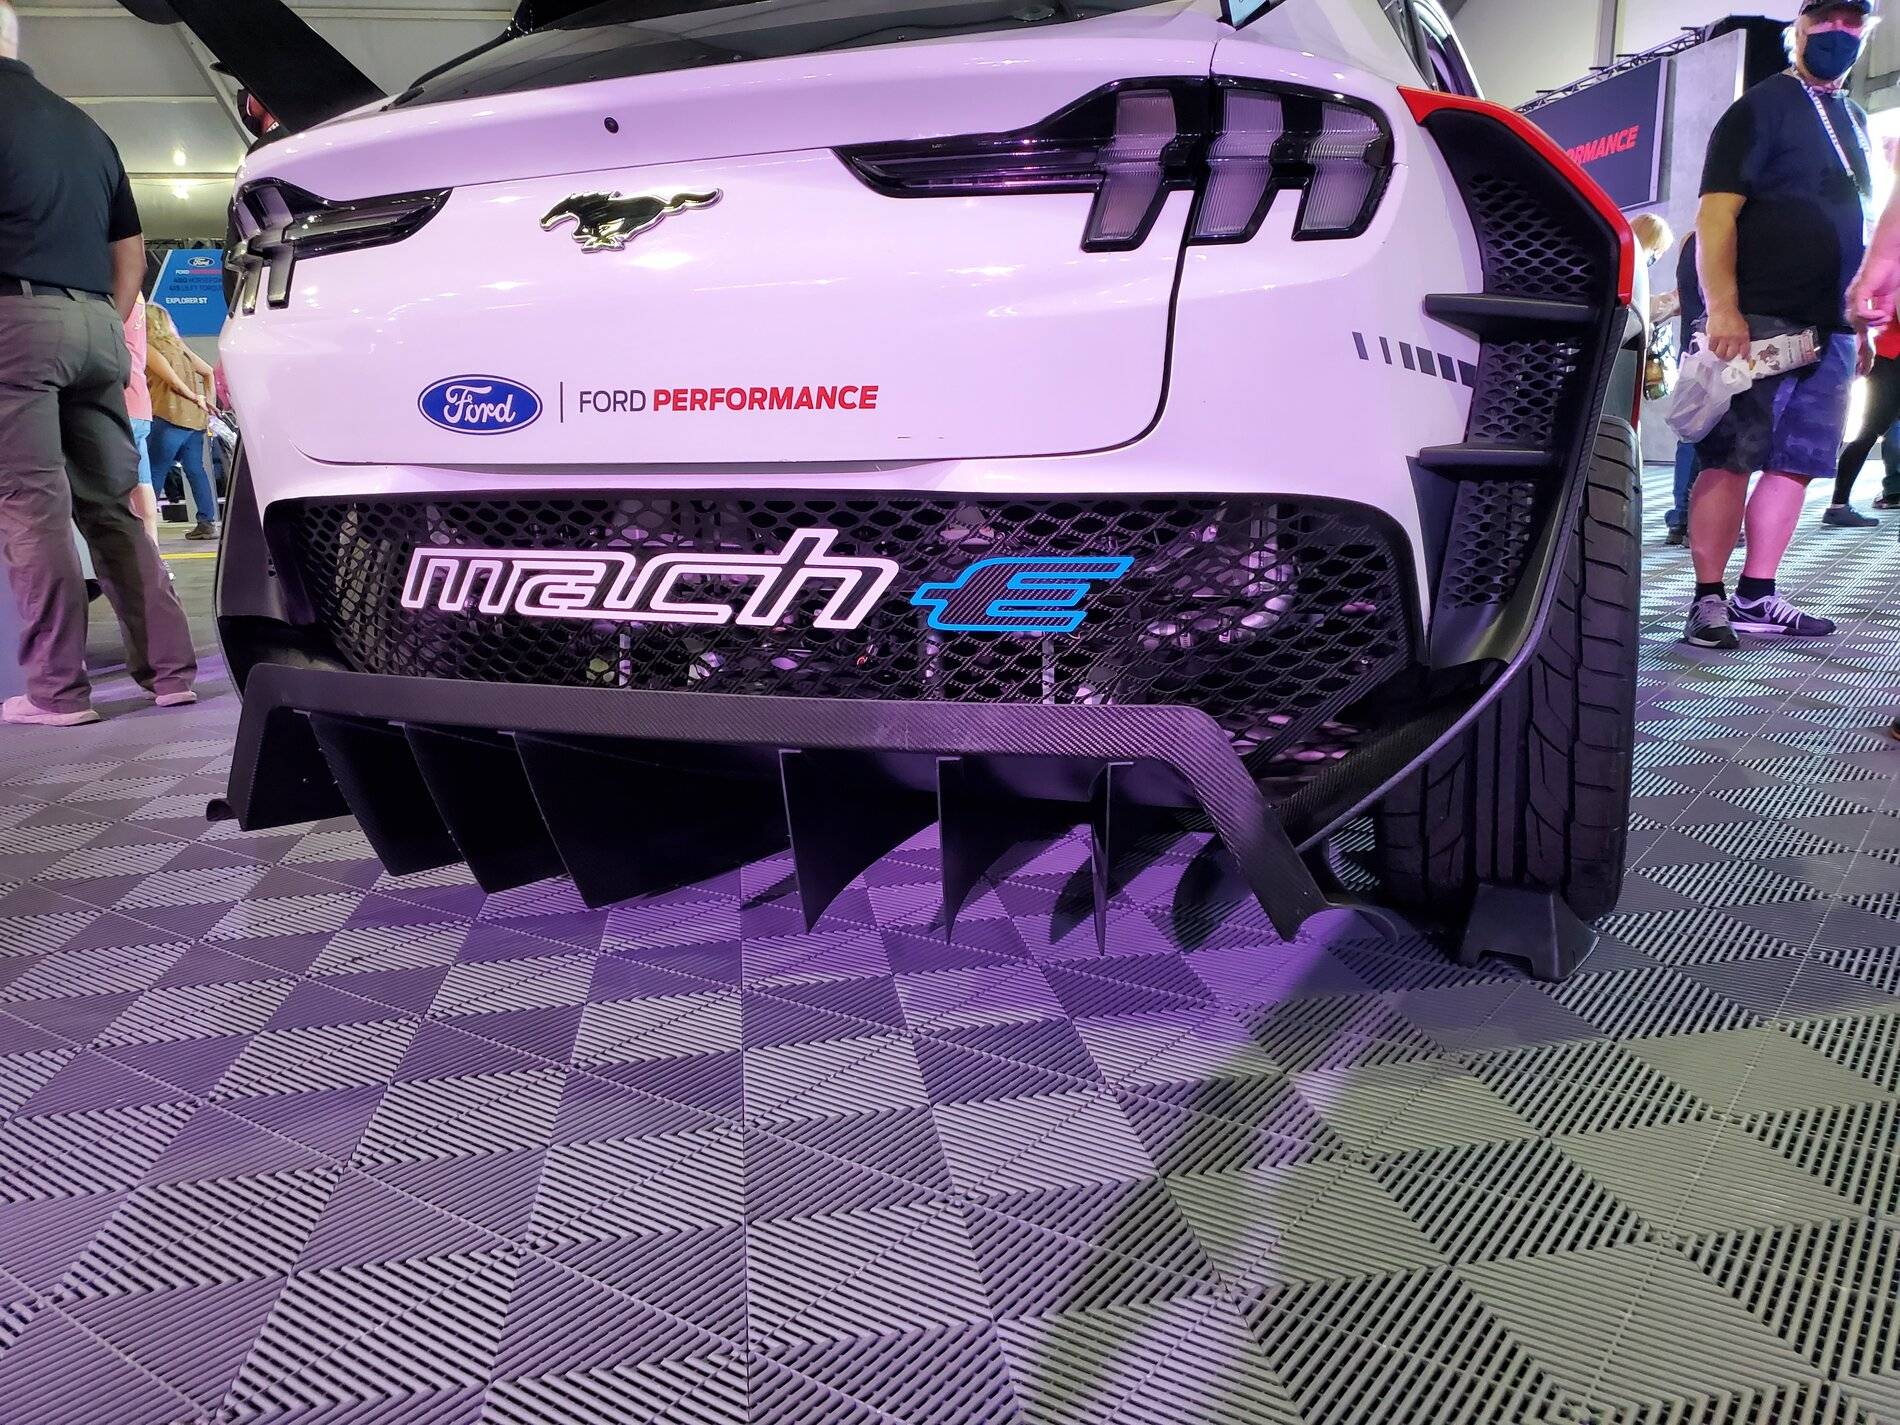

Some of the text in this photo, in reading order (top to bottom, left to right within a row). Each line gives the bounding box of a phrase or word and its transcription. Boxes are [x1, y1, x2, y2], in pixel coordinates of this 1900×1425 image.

[443, 384, 516, 424] Ford
[579, 385, 880, 413] FORD PERFORMANCE
[910, 556, 1135, 632] E
